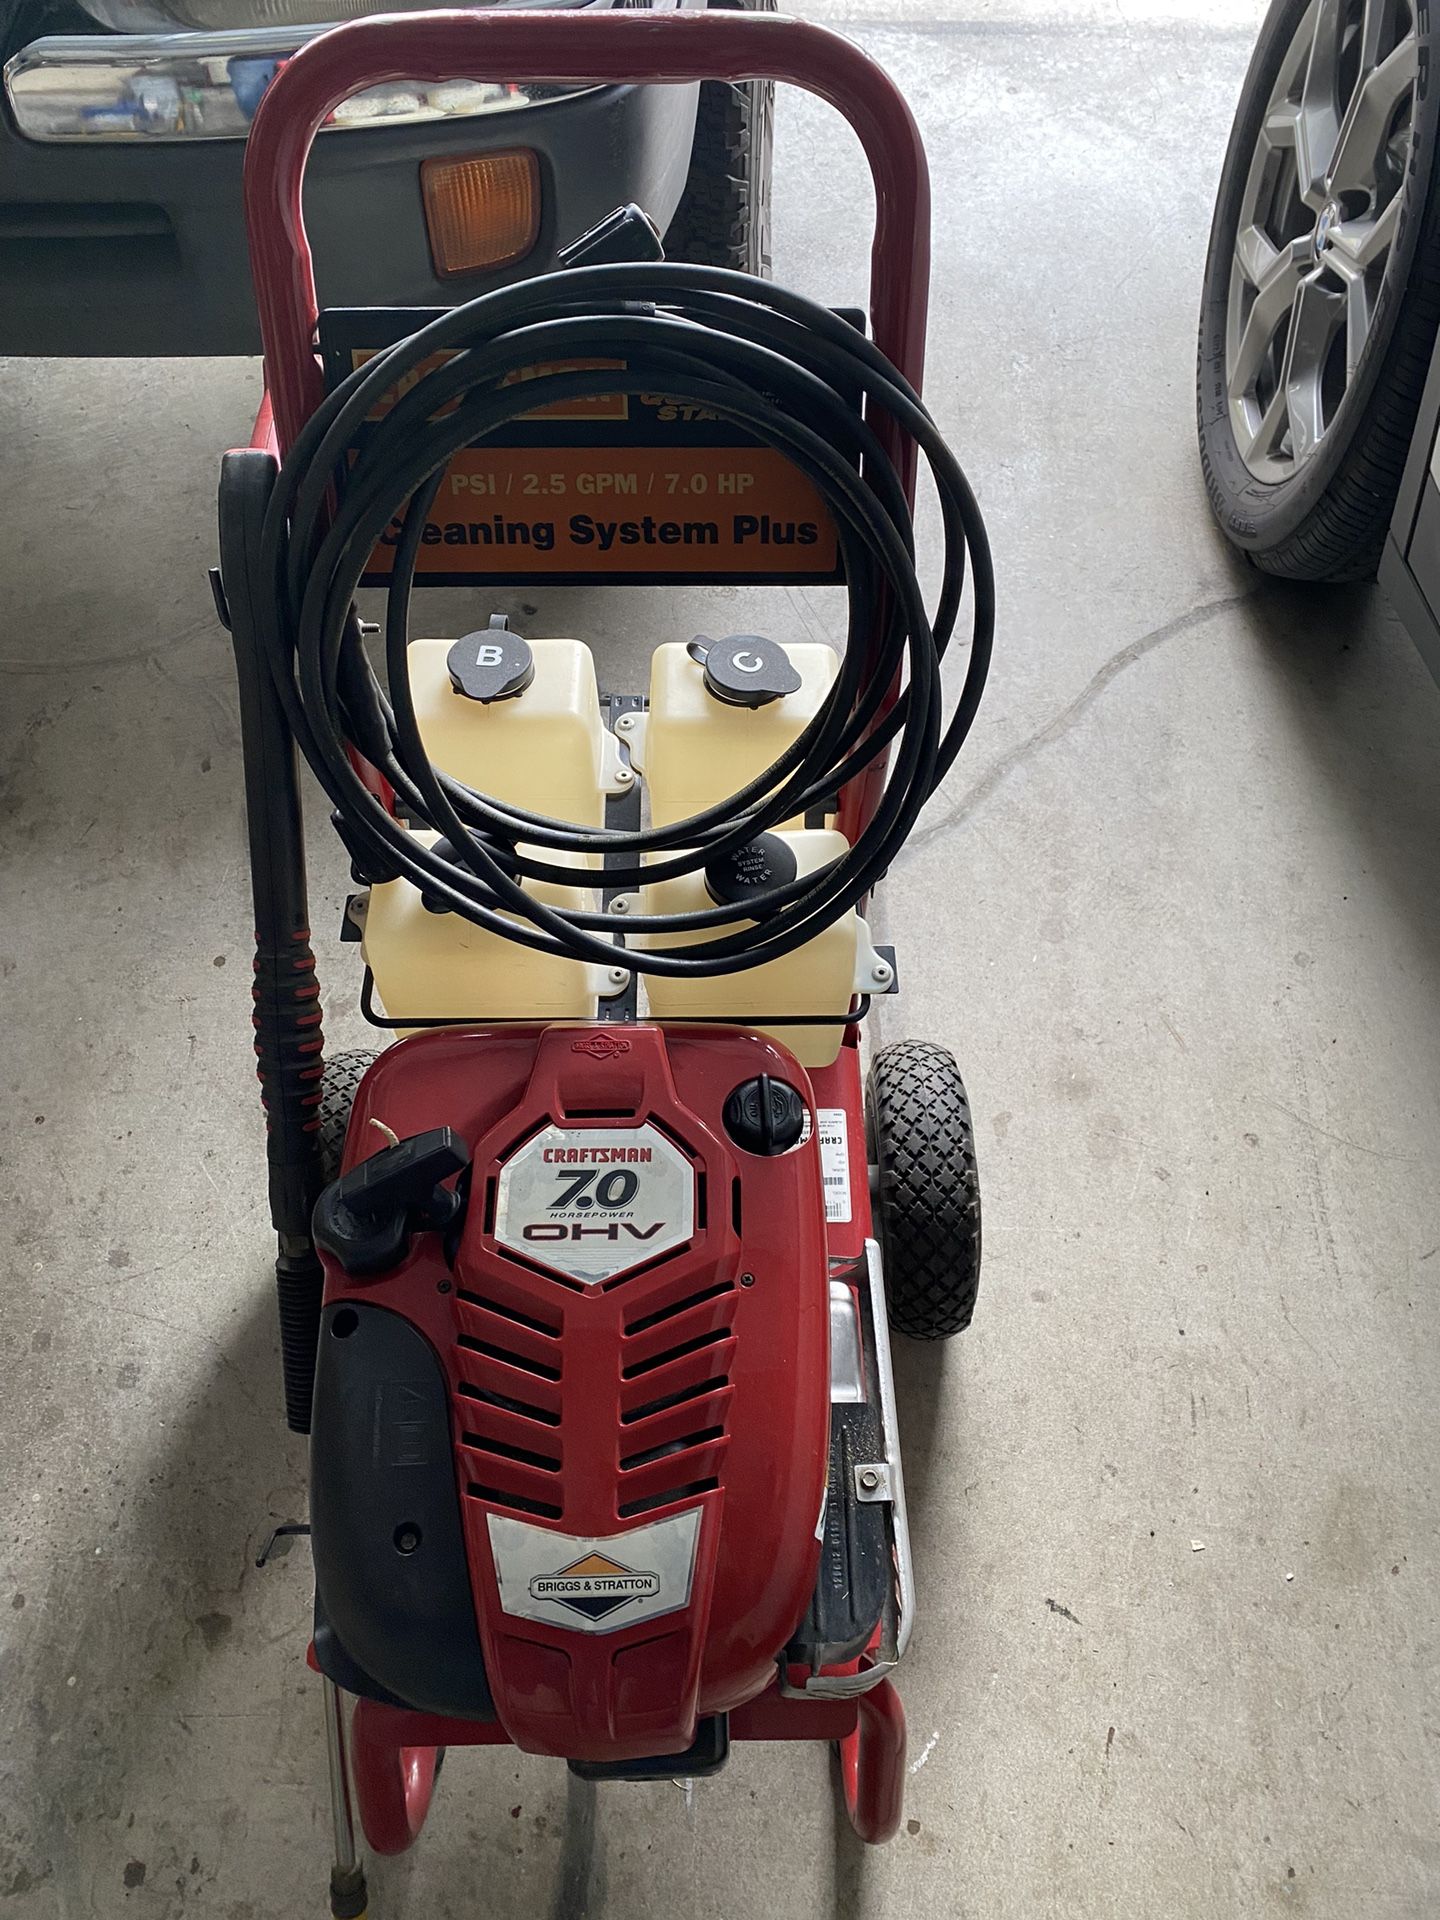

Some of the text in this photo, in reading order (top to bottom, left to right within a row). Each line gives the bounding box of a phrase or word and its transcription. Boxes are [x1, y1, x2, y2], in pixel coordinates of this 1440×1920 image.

[657, 405, 720, 421] STA
[451, 473, 754, 495] PSI / 2.5 GPM / 7.0 HP
[379, 514, 818, 550] Ceaning System Plus
[476, 645, 503, 666] B
[732, 651, 763, 672] C
[731, 847, 765, 860] WATER
[738, 857, 764, 867] SYSTEM
[736, 869, 772, 883] WATER
[543, 1148, 652, 1163] CRAFTSMAN
[546, 1168, 640, 1210] 7.0
[523, 1223, 666, 1241] OHV
[538, 1579, 652, 1592] BRIGGS & STRATTON
